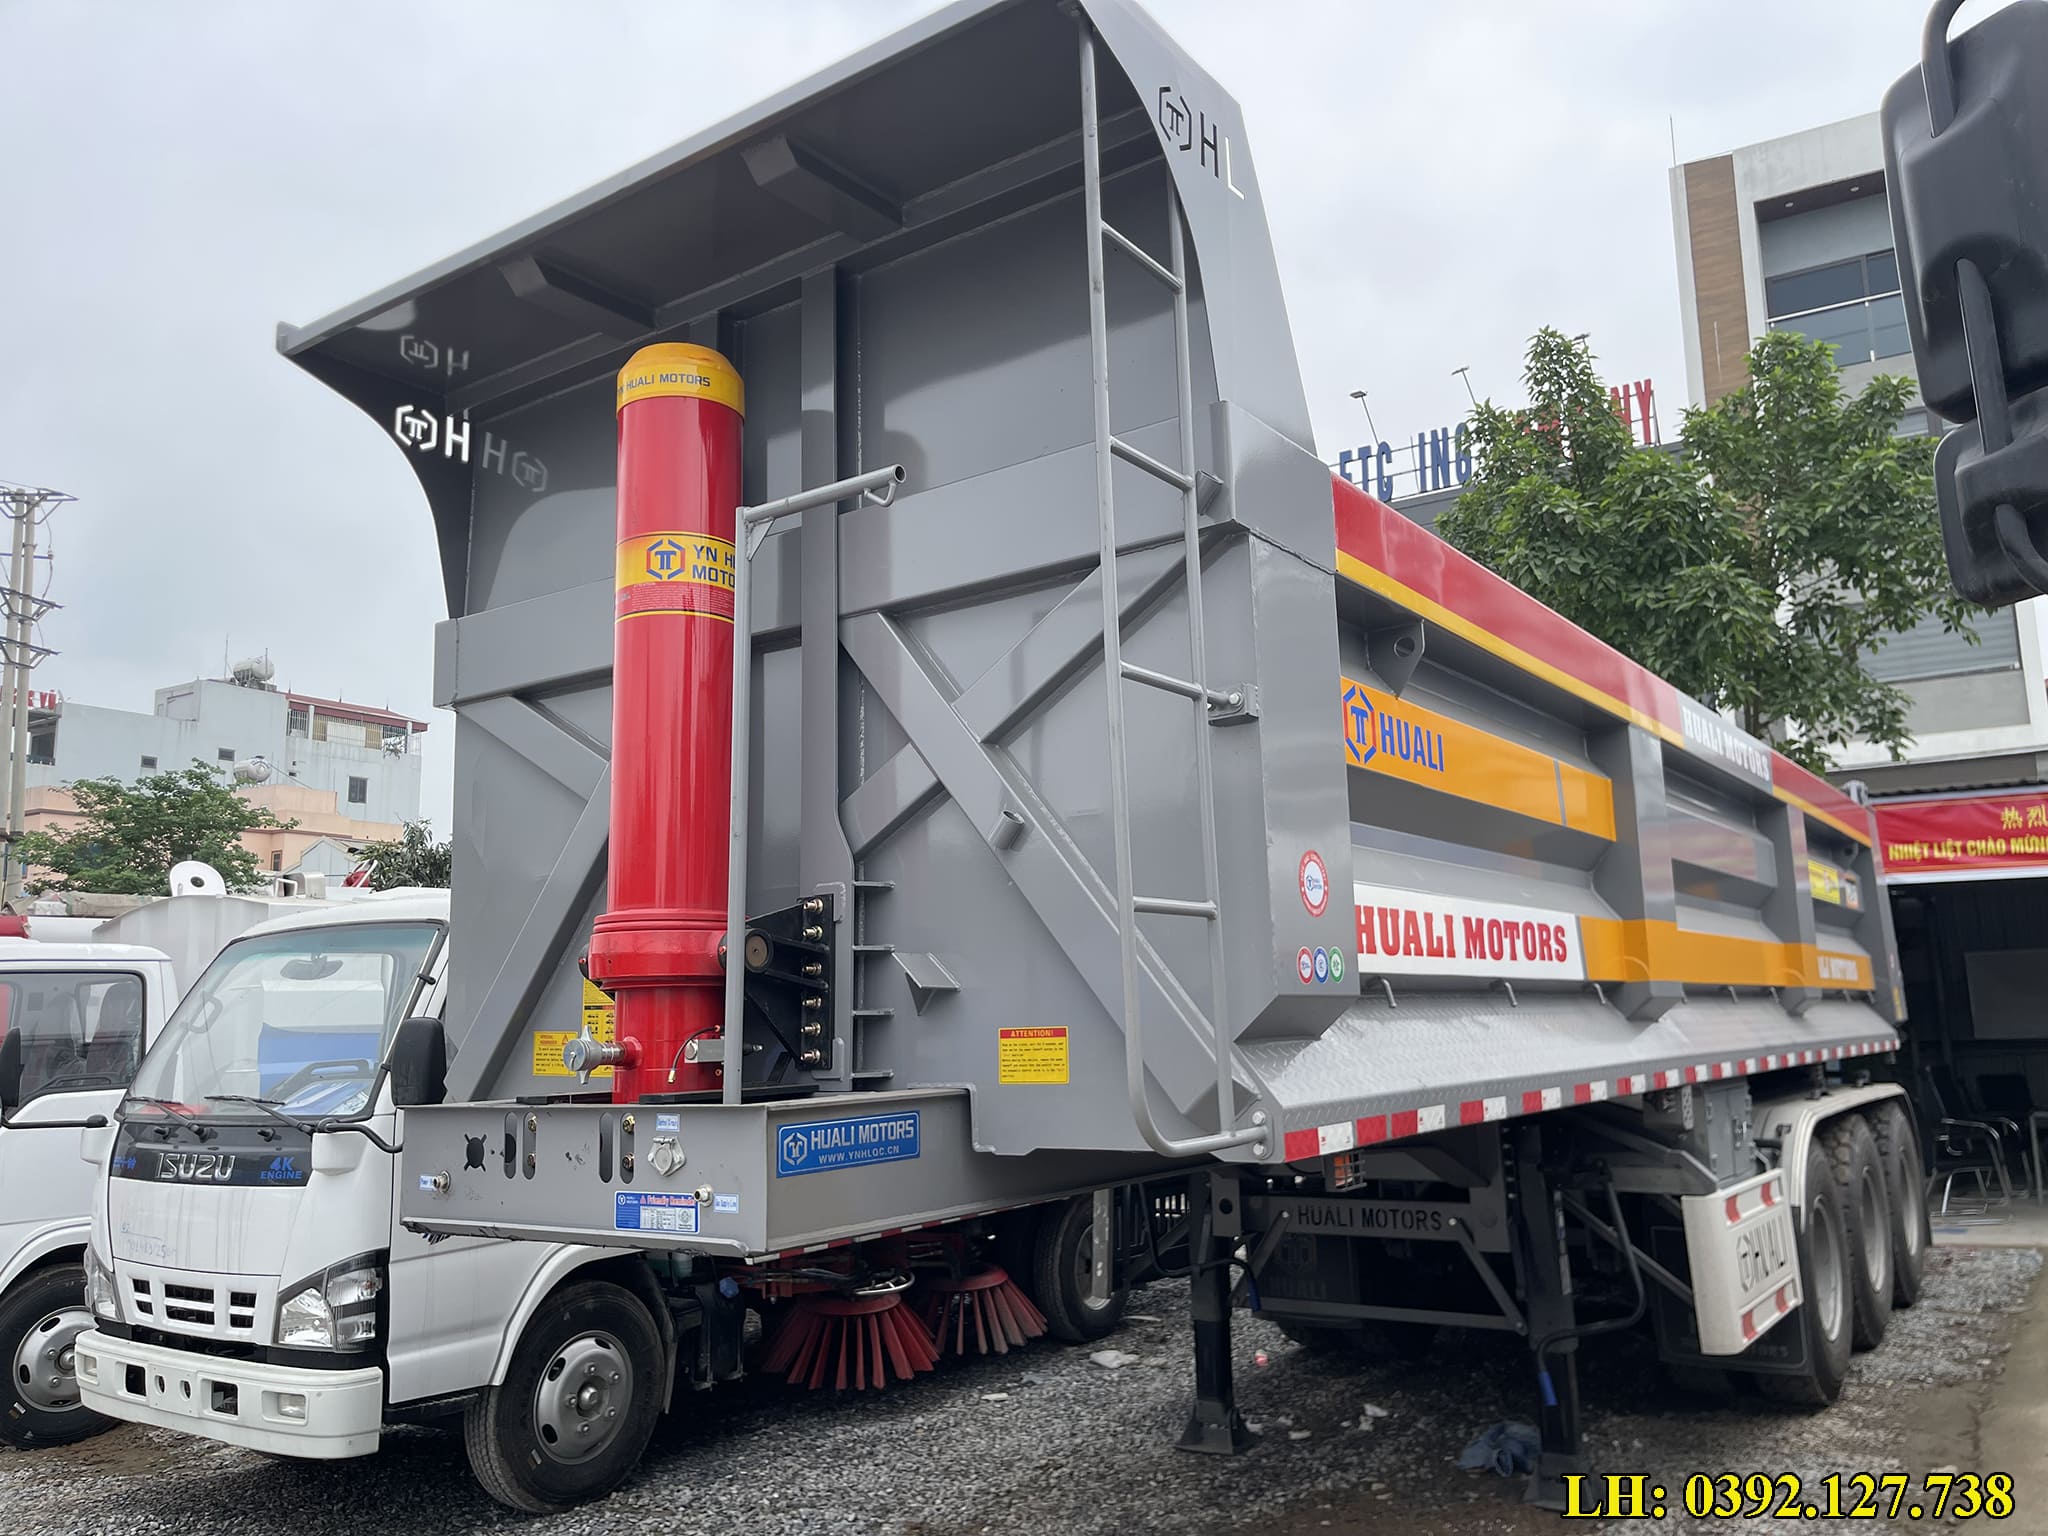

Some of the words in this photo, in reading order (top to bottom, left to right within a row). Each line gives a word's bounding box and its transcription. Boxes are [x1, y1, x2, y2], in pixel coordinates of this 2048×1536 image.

[626, 374, 655, 391] HUALI
[659, 373, 711, 387] MOTORS
[693, 543, 718, 563] YN
[1381, 712, 1444, 772] HUALI
[2010, 833, 2048, 855] MỪN
[1355, 904, 1456, 958] HUALI
[1463, 915, 1567, 963] MOTORS
[1010, 1029, 1054, 1037] ATTENTION!
[811, 1125, 855, 1151] HUALI
[859, 1119, 914, 1144] MOTORS
[156, 1152, 236, 1181] ISUZU
[260, 1170, 302, 1179] ENGINE
[269, 1156, 295, 1171] 4K
[1298, 1205, 1353, 1227] HUALI
[1361, 1207, 1442, 1231] MOTORS
